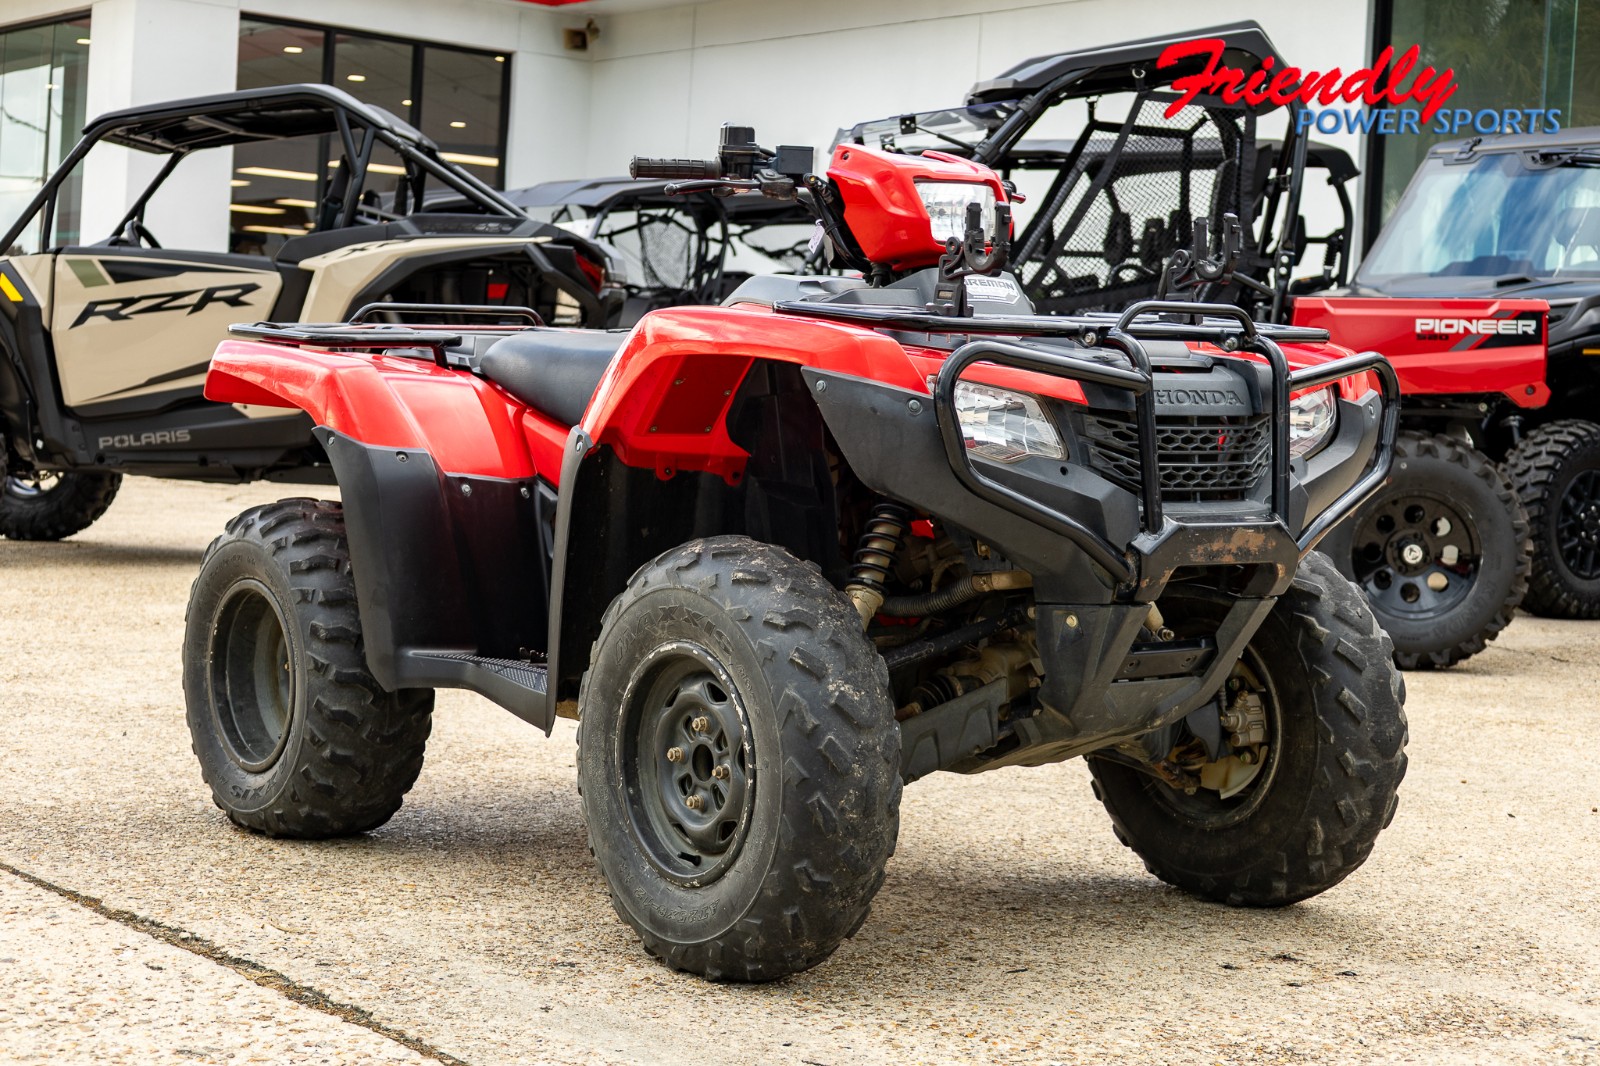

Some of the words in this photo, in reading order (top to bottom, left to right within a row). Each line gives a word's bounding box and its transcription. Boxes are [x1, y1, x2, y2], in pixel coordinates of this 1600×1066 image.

[69, 282, 262, 330] RZR
[1415, 318, 1537, 335] PIONEER
[1153, 389, 1245, 406] HONDA
[98, 429, 191, 450] POLARIS
[614, 604, 735, 667] MAXXIS
